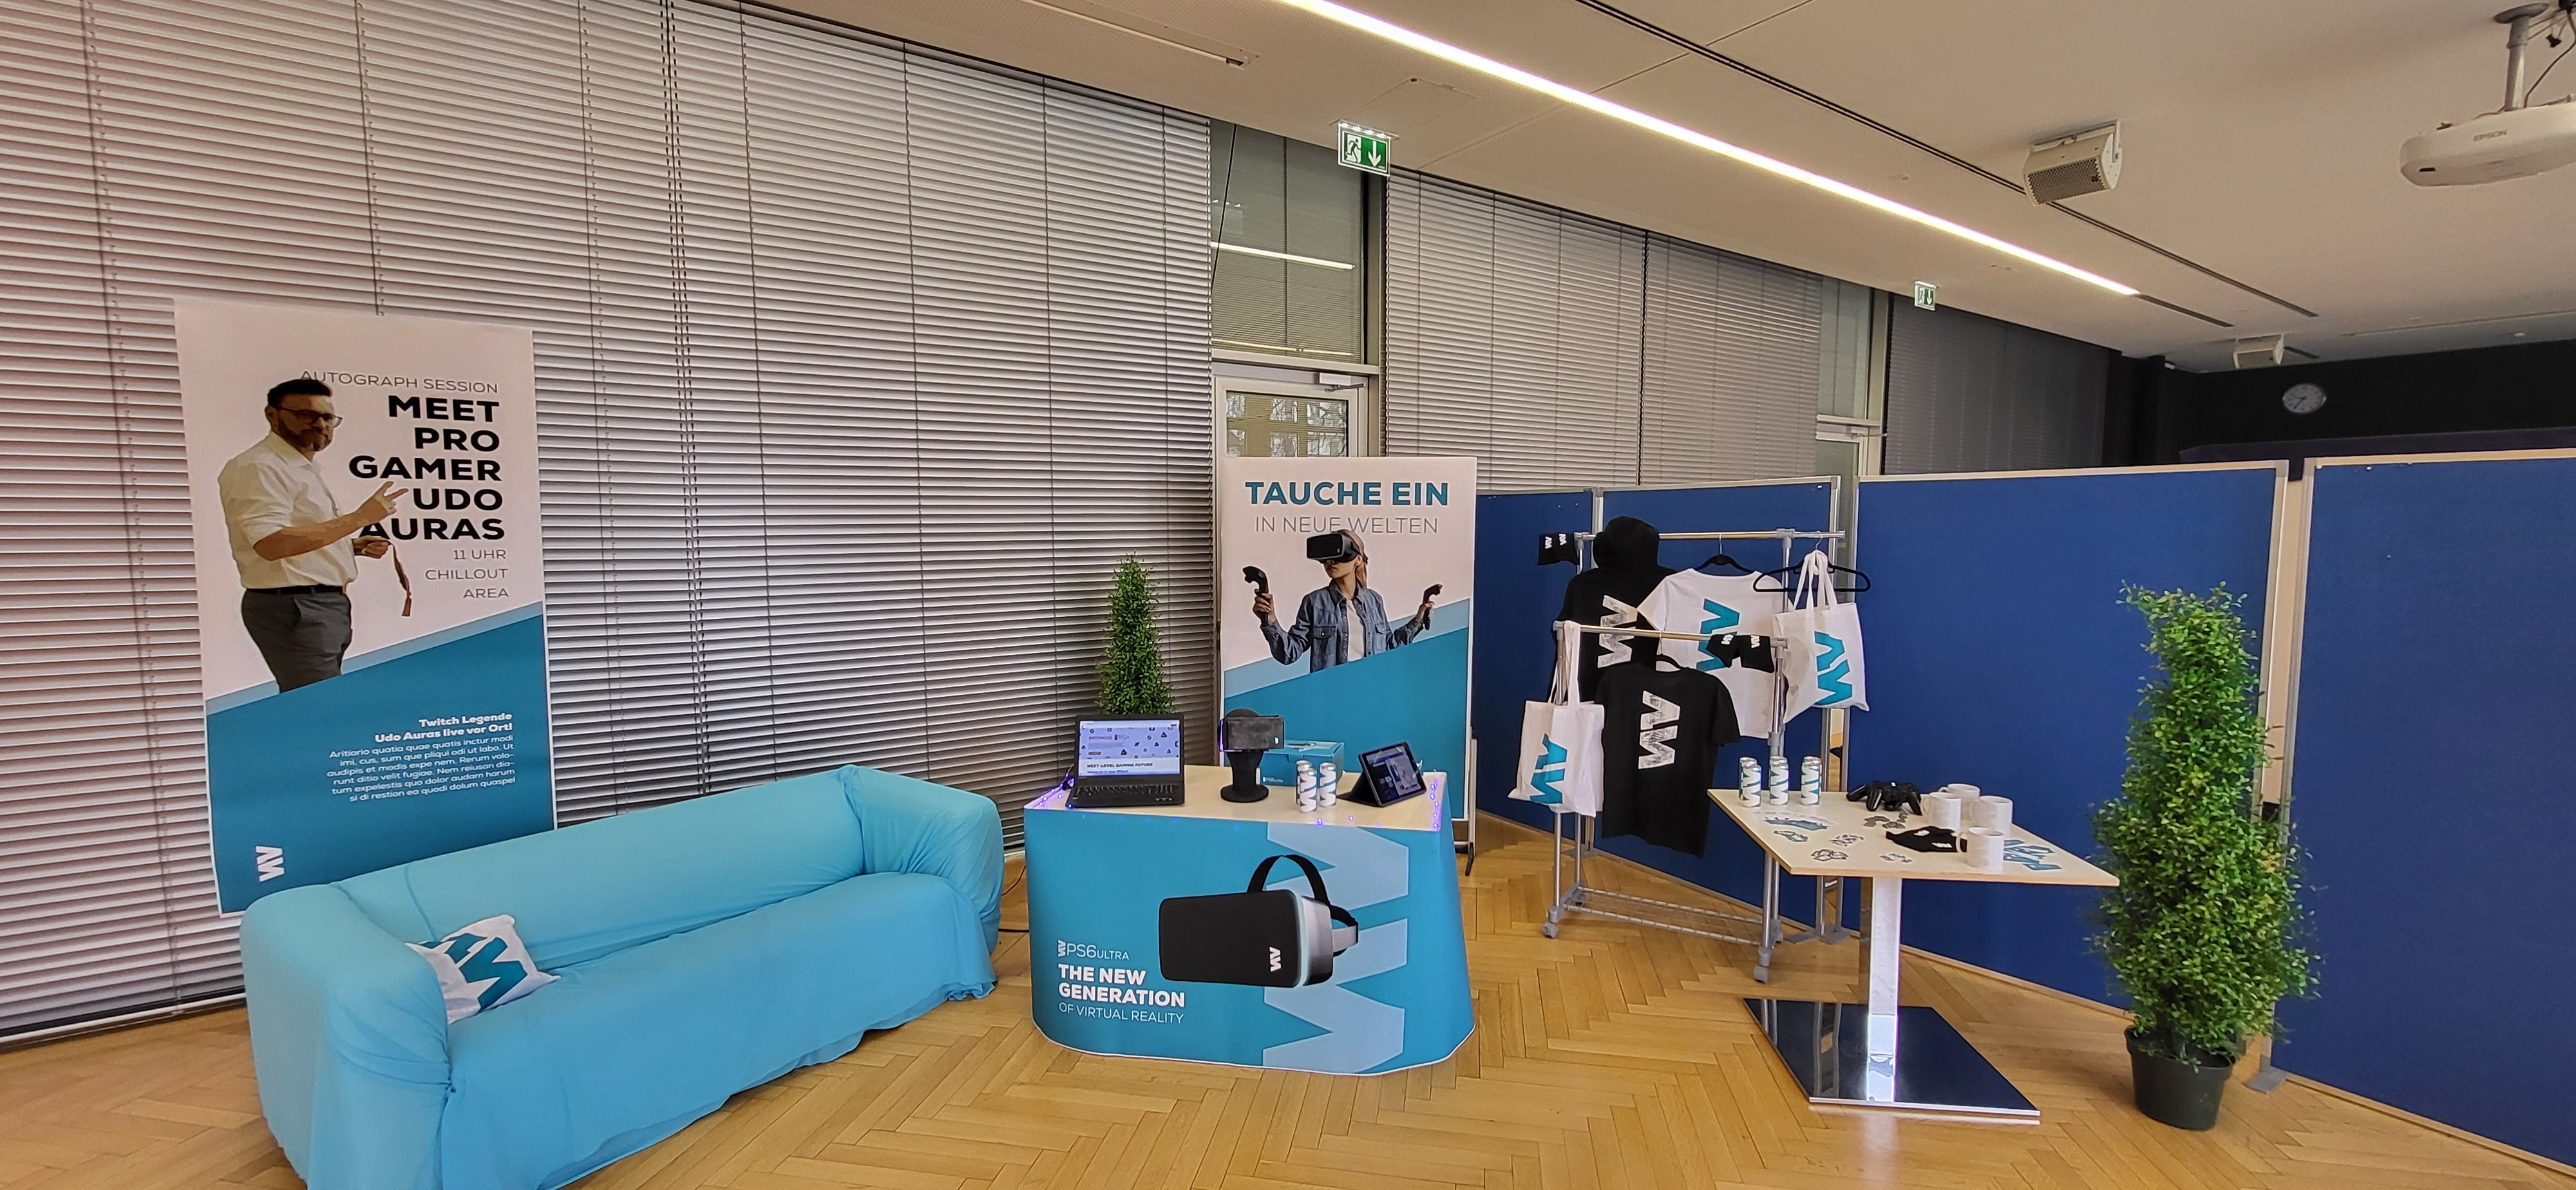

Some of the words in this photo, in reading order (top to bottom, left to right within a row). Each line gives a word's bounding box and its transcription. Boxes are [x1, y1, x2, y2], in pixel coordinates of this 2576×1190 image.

[301, 371, 417, 388] AUTOGRAPH
[424, 379, 498, 393] SESSION
[388, 395, 500, 422] MEET
[415, 427, 500, 451] PRO
[348, 455, 502, 482] GAMER
[413, 488, 503, 511] UDO
[1244, 481, 1382, 505] TAUCHE
[1392, 482, 1448, 505] EIN
[358, 518, 506, 541] AURAS
[1256, 516, 1275, 533] IN
[1283, 516, 1341, 533] NEUE
[1347, 517, 1438, 534] WELTEN
[453, 549, 466, 560] 11
[471, 549, 507, 560] UHR
[425, 569, 508, 581] CHILLOUT
[463, 588, 509, 599] AREA
[419, 717, 459, 727] Twitch
[462, 713, 512, 724] Legende
[375, 733, 401, 742] Udo
[402, 731, 440, 740] Auras
[488, 723, 512, 732] Ort!
[409, 760, 432, 769] expe
[371, 791, 404, 799] restion
[421, 785, 447, 795] quodi
[450, 782, 478, 790] dolum
[480, 777, 515, 787] quaspel
[451, 773, 483, 781] audam
[1058, 963, 1094, 982] THE
[1099, 968, 1146, 985] NEW
[1059, 983, 1186, 1007] GENERATION
[1059, 1003, 1074, 1014] OF
[1075, 1005, 1128, 1021] VIRTUAL
[1131, 1010, 1184, 1024] REALITY
